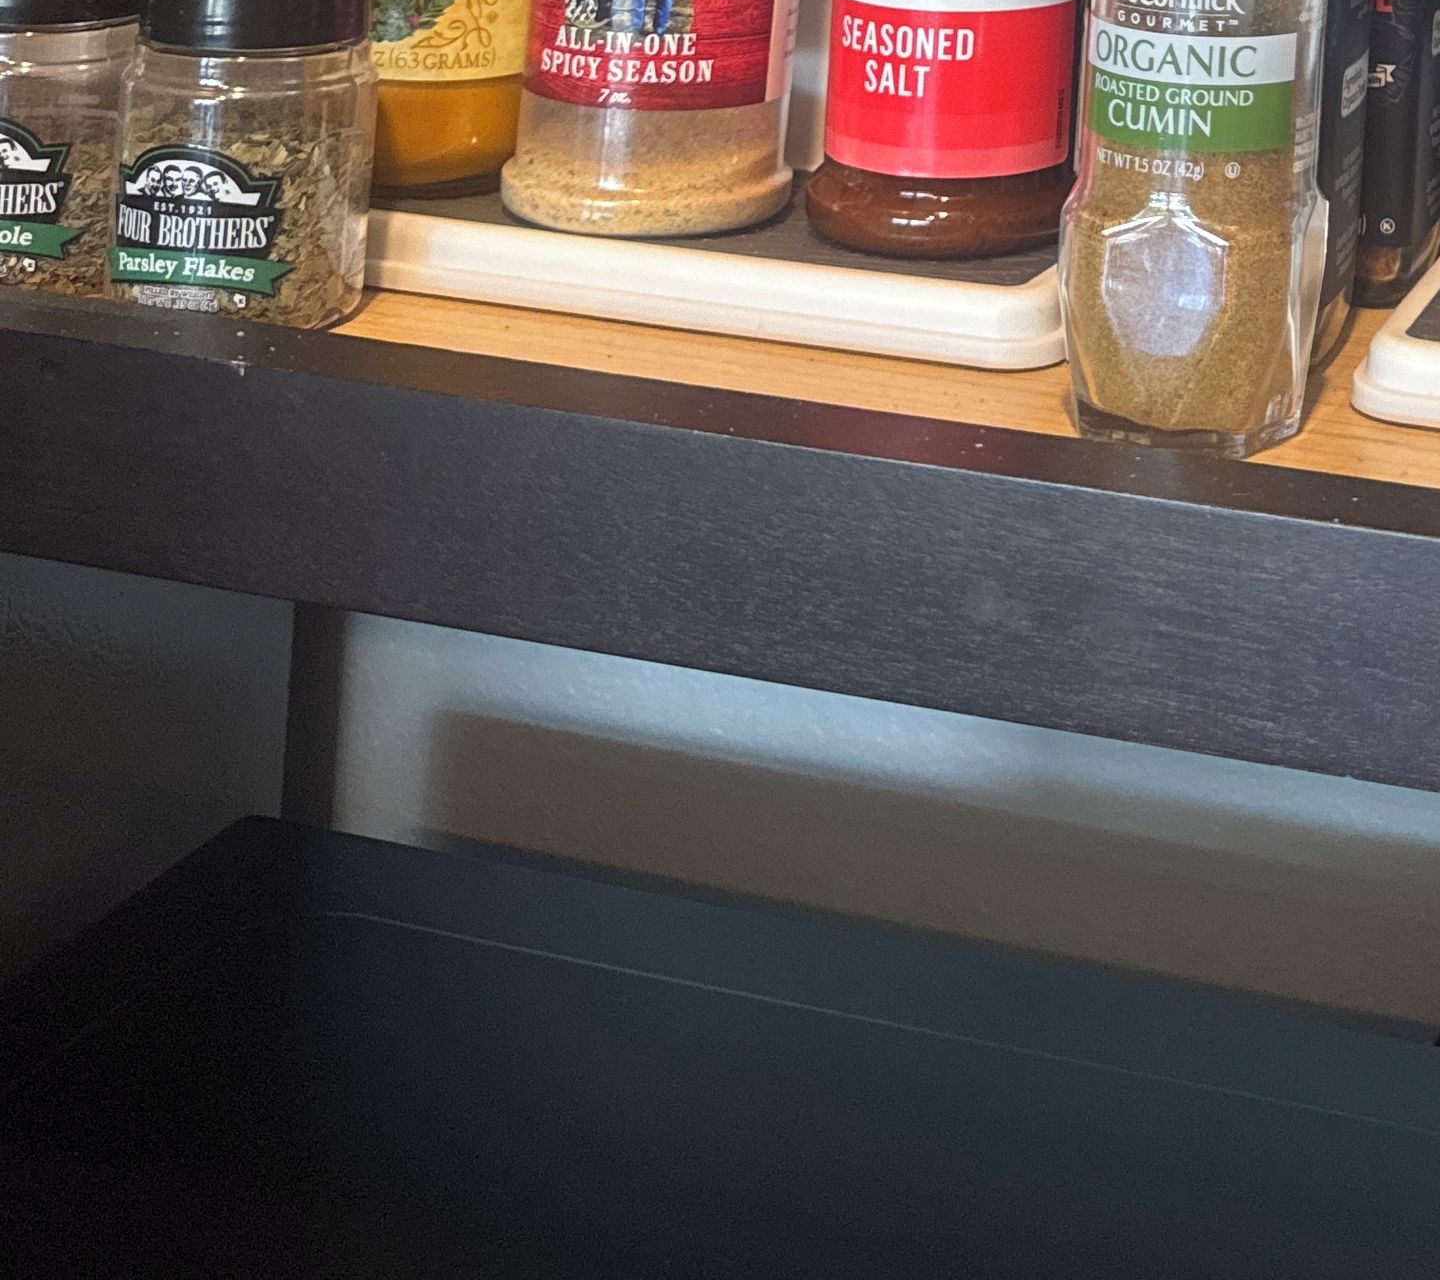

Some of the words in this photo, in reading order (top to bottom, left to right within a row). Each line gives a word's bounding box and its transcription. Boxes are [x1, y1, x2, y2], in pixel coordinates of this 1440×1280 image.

[842, 14, 975, 62] SEASONED
[1117, 10, 1227, 33] GOURMET
[554, 24, 697, 58] ALL-IN-ONE
[1097, 29, 1256, 79] ORGANIC
[541, 50, 601, 82] SPICY
[607, 58, 714, 83] SEASON
[865, 58, 930, 99] SALT
[1094, 70, 1159, 103] ROASTED
[1165, 85, 1253, 108] GROUND
[1108, 101, 1212, 138] CUMIN
[117, 204, 152, 245] FOUR
[159, 215, 269, 251] BROTHERS
[119, 252, 177, 280] Parsley
[182, 257, 255, 282] Flakes
